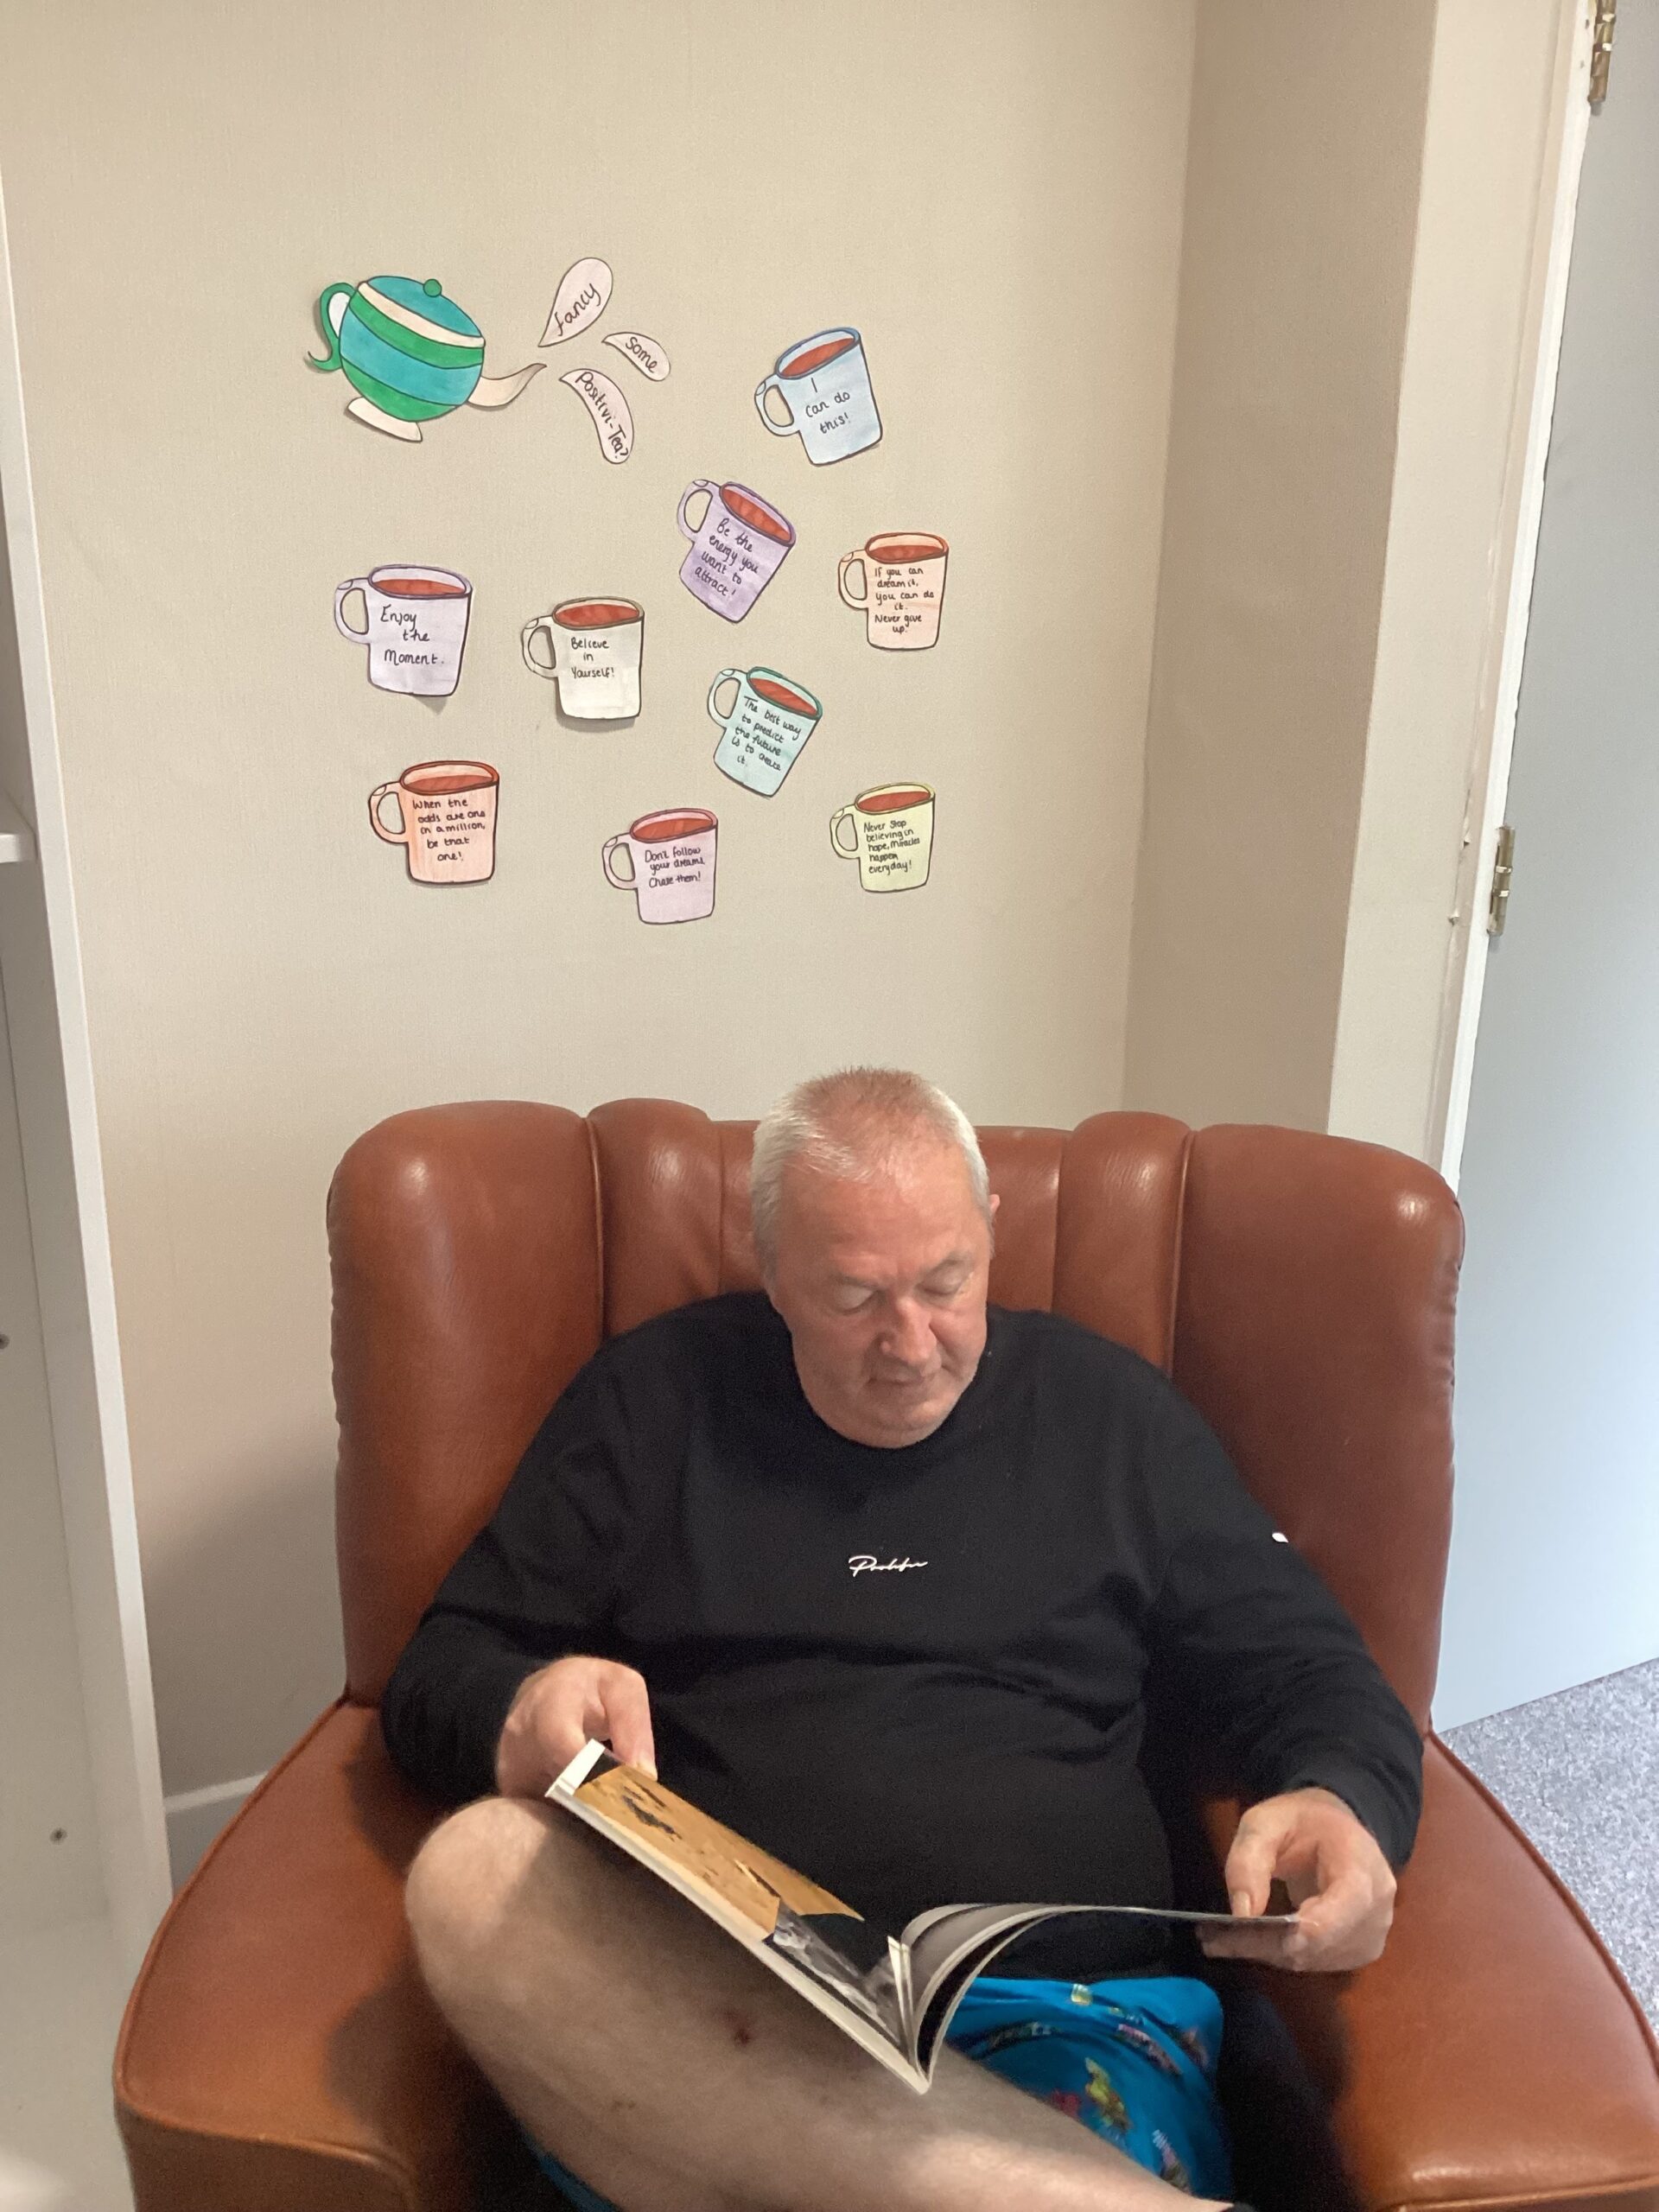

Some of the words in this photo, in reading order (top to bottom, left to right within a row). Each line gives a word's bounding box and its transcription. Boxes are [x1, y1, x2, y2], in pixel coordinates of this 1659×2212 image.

[554, 283, 601, 337] fancy
[810, 377, 818, 393] I
[805, 401, 830, 417] can
[834, 391, 850, 404] do
[819, 411, 850, 434] this!
[716, 518, 730, 537] Be
[734, 531, 753, 553] the
[709, 535, 738, 567] energy
[739, 556, 759, 574] you
[701, 551, 728, 575] want
[732, 572, 742, 585] to
[874, 566, 882, 578] If
[886, 569, 902, 581] you
[877, 579, 906, 588] dream
[875, 592, 896, 607] you
[923, 589, 934, 598] do
[380, 603, 416, 632] Enjoy
[874, 613, 900, 623] Never
[904, 614, 922, 628] give
[403, 629, 430, 642] the
[570, 636, 610, 651] Believe
[583, 652, 594, 662] in
[744, 696, 758, 713] The
[764, 709, 781, 725] best
[782, 721, 802, 741] way
[741, 714, 752, 724] to
[753, 722, 785, 744] predict
[734, 726, 750, 739] the
[752, 734, 782, 756] future
[745, 743, 754, 753] to
[759, 753, 781, 772] create
[412, 799, 442, 810] When
[448, 799, 468, 808] the
[417, 813, 441, 823] odds
[446, 812, 465, 821] are
[420, 826, 431, 835] in
[863, 822, 886, 833] Never
[427, 839, 438, 849] be
[444, 836, 469, 846] that
[866, 830, 904, 842] believing
[437, 851, 464, 861] one!
[645, 849, 670, 863] Don't
[672, 846, 702, 858] follow
[868, 853, 899, 862] happen
[650, 861, 670, 876] your
[676, 871, 701, 883] them!
